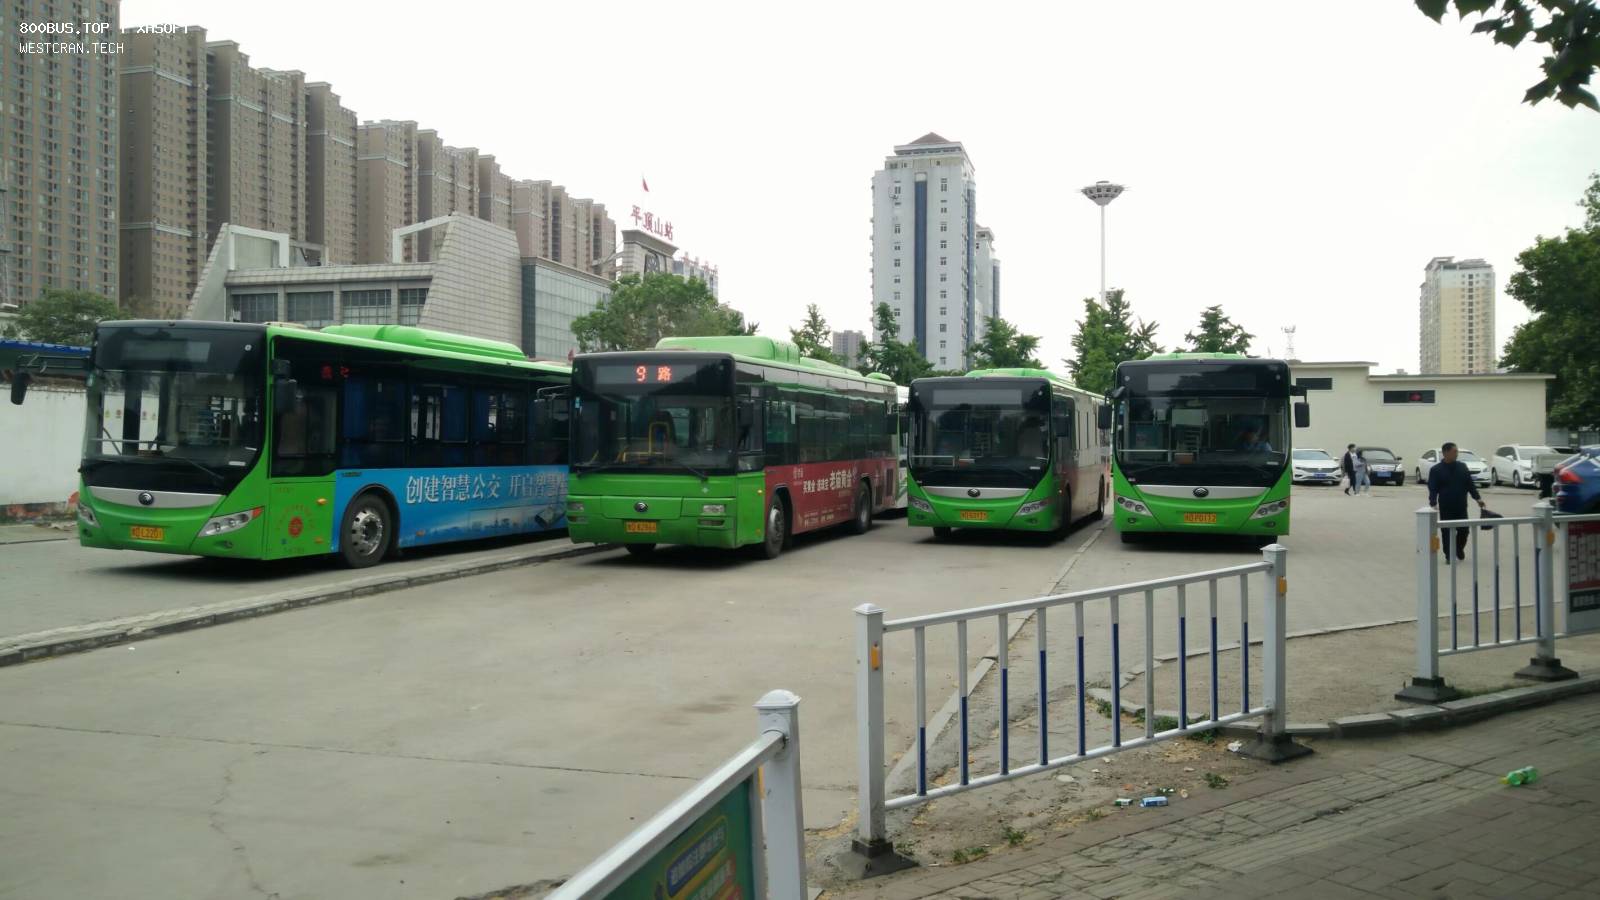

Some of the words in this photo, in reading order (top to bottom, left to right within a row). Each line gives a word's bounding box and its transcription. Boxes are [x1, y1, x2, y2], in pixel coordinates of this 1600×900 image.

[636, 366, 646, 381] 9
[406, 473, 501, 504] 创建智慧公交
